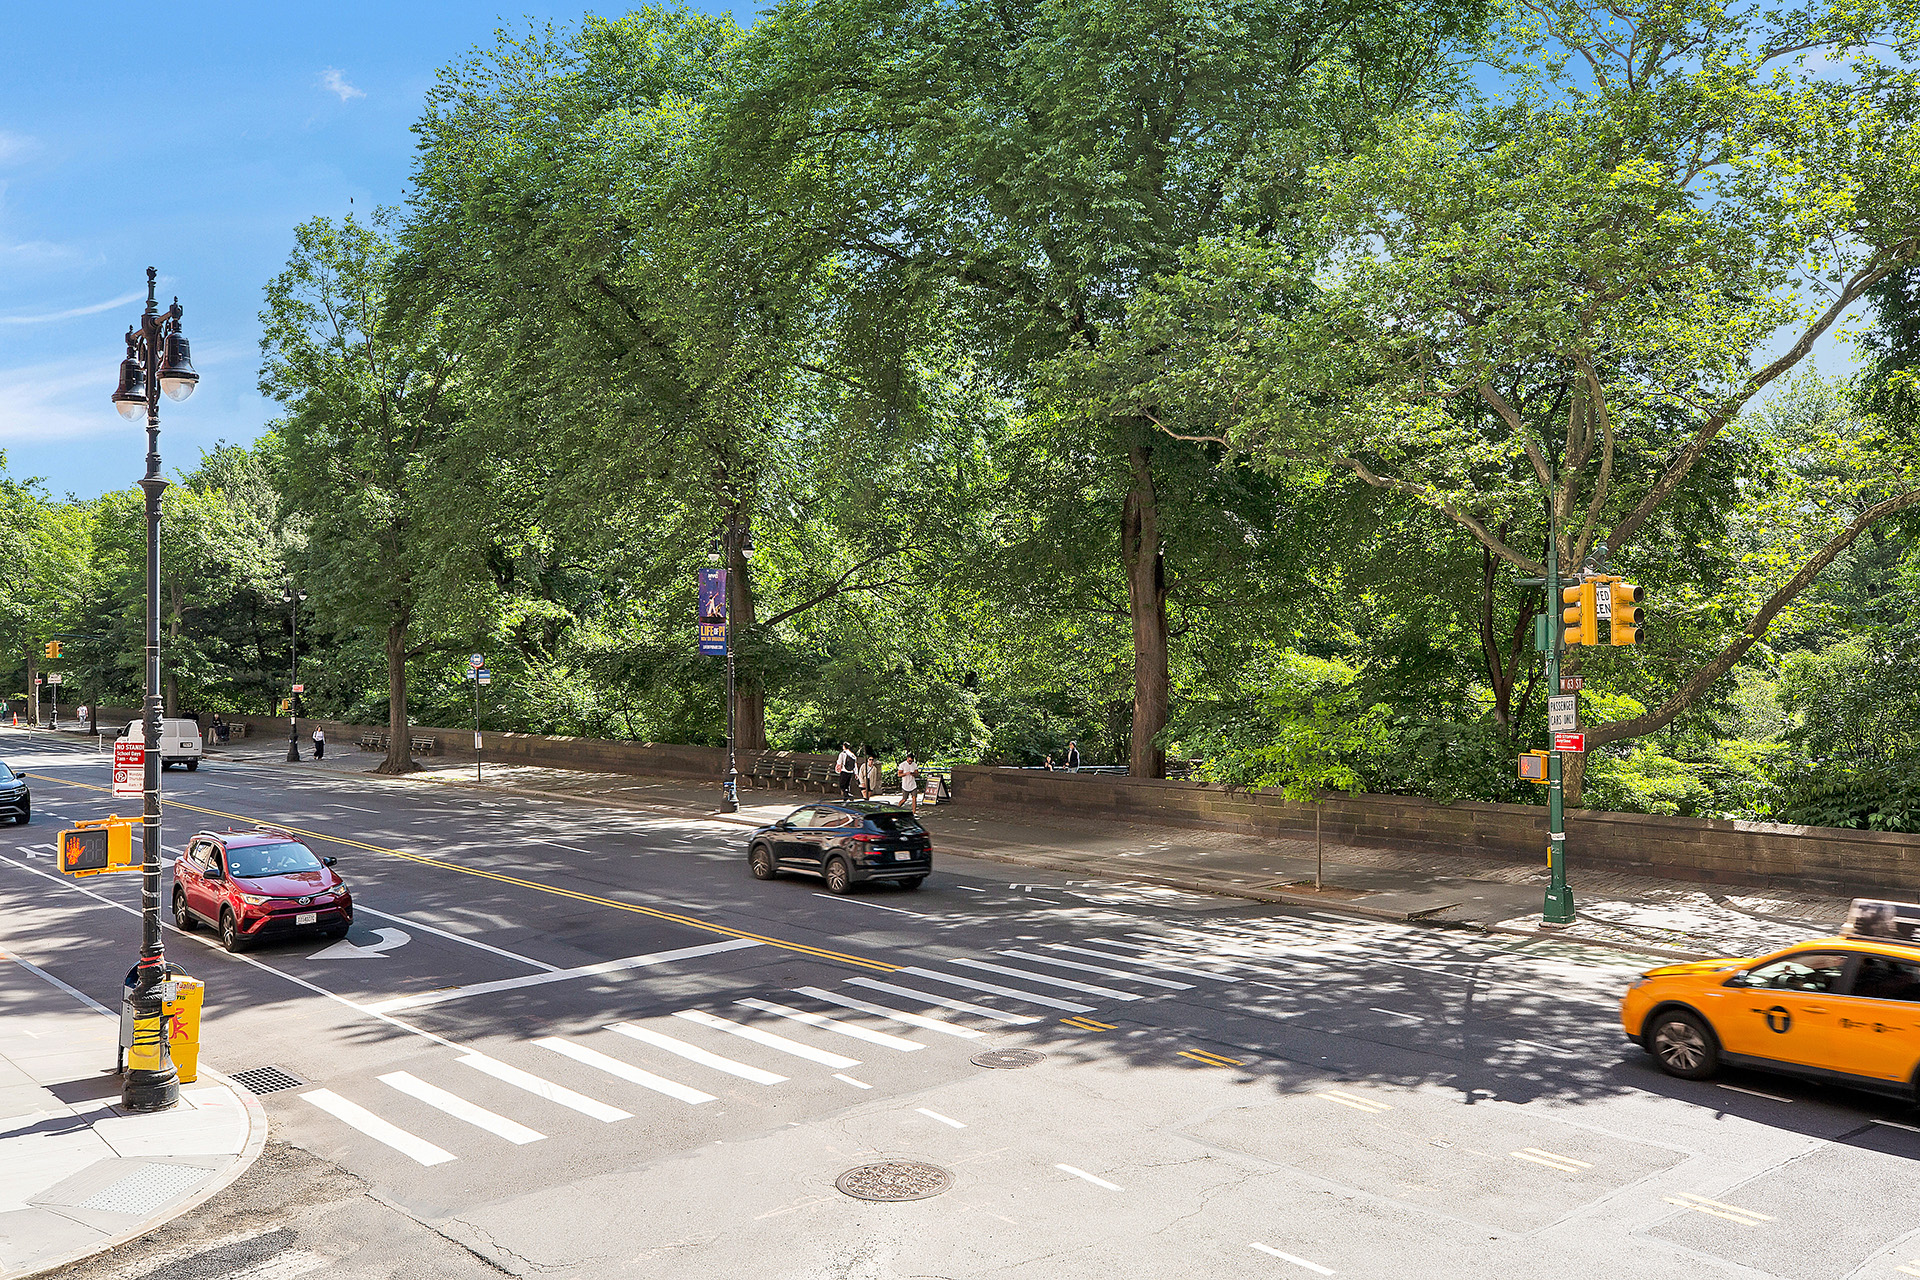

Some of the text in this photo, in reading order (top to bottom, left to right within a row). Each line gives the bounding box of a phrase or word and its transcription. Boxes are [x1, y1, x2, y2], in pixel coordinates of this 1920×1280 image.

[700, 626, 714, 636] LIFE
[718, 626, 725, 636] PI
[1567, 678, 1573, 689] 63
[1550, 700, 1574, 712] PASSENGER
[1551, 714, 1574, 726] CARS ONLY
